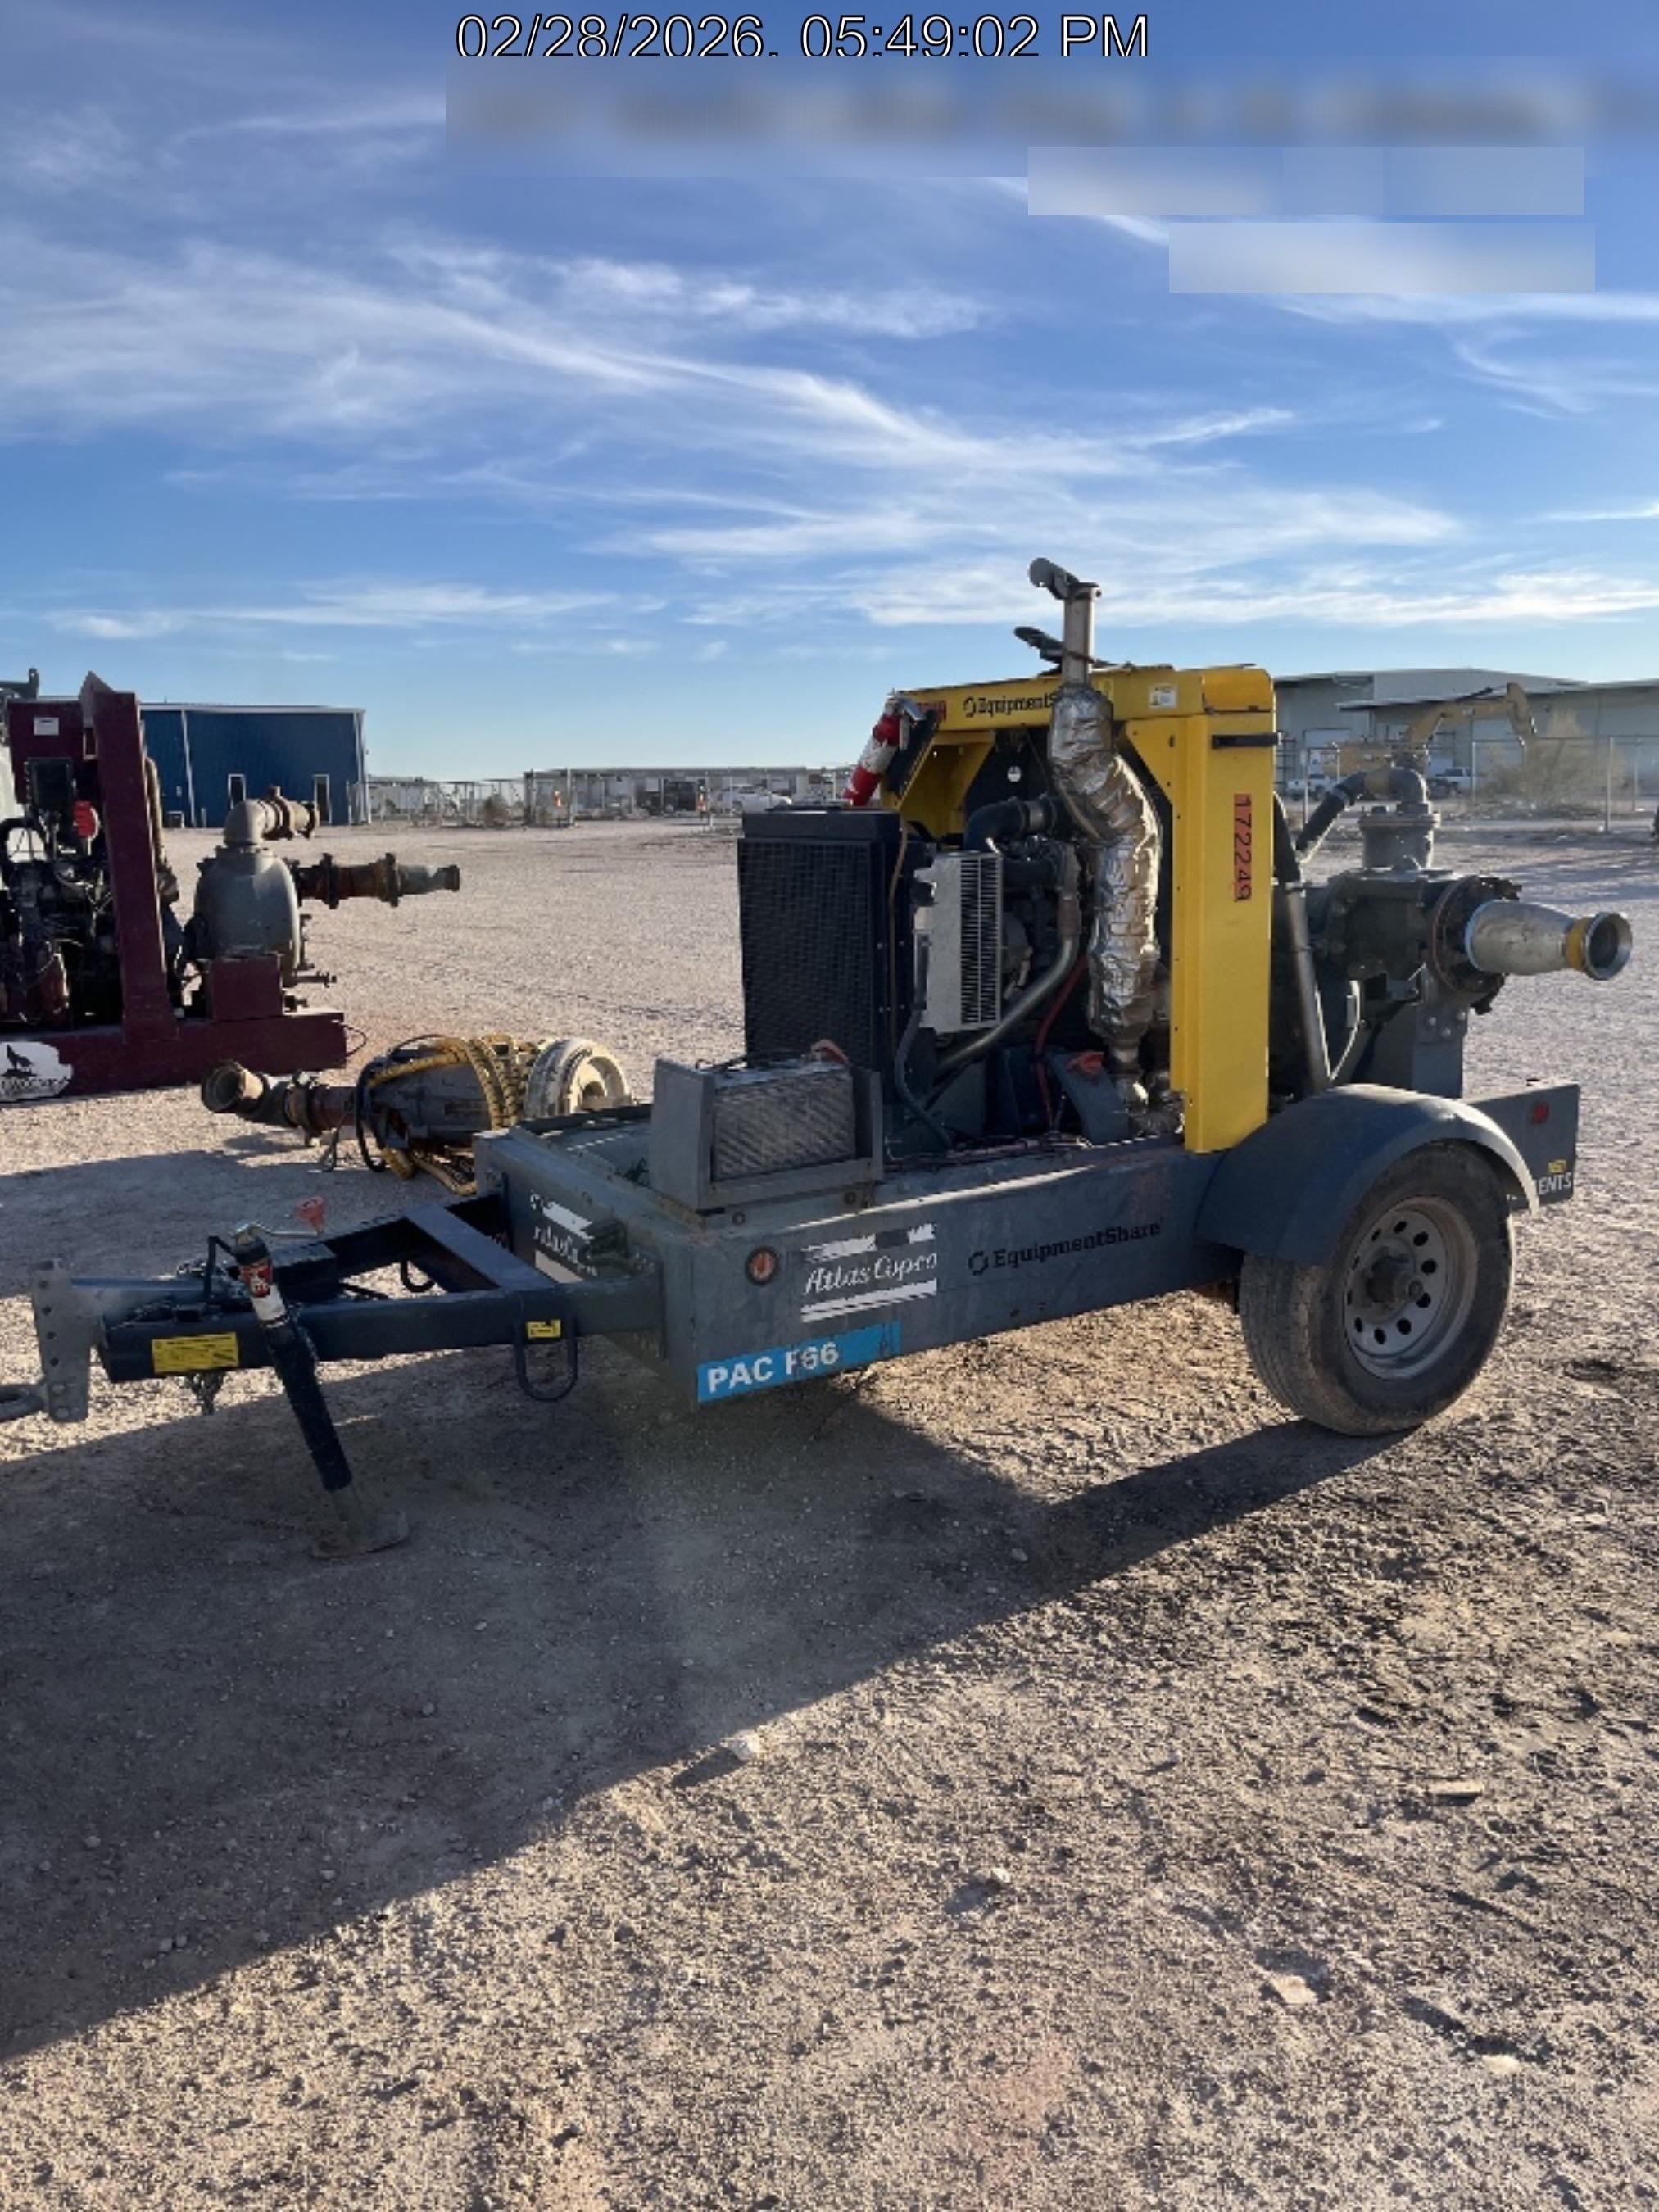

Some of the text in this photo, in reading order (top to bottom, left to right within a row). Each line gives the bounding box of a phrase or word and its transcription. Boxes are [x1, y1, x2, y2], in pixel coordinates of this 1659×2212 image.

[1537, 1172, 1572, 1195] ENTS
[992, 1222, 1162, 1269] EquipmentShare
[802, 1253, 938, 1296] Atlas Copco
[706, 1340, 840, 1393] PAC F66
